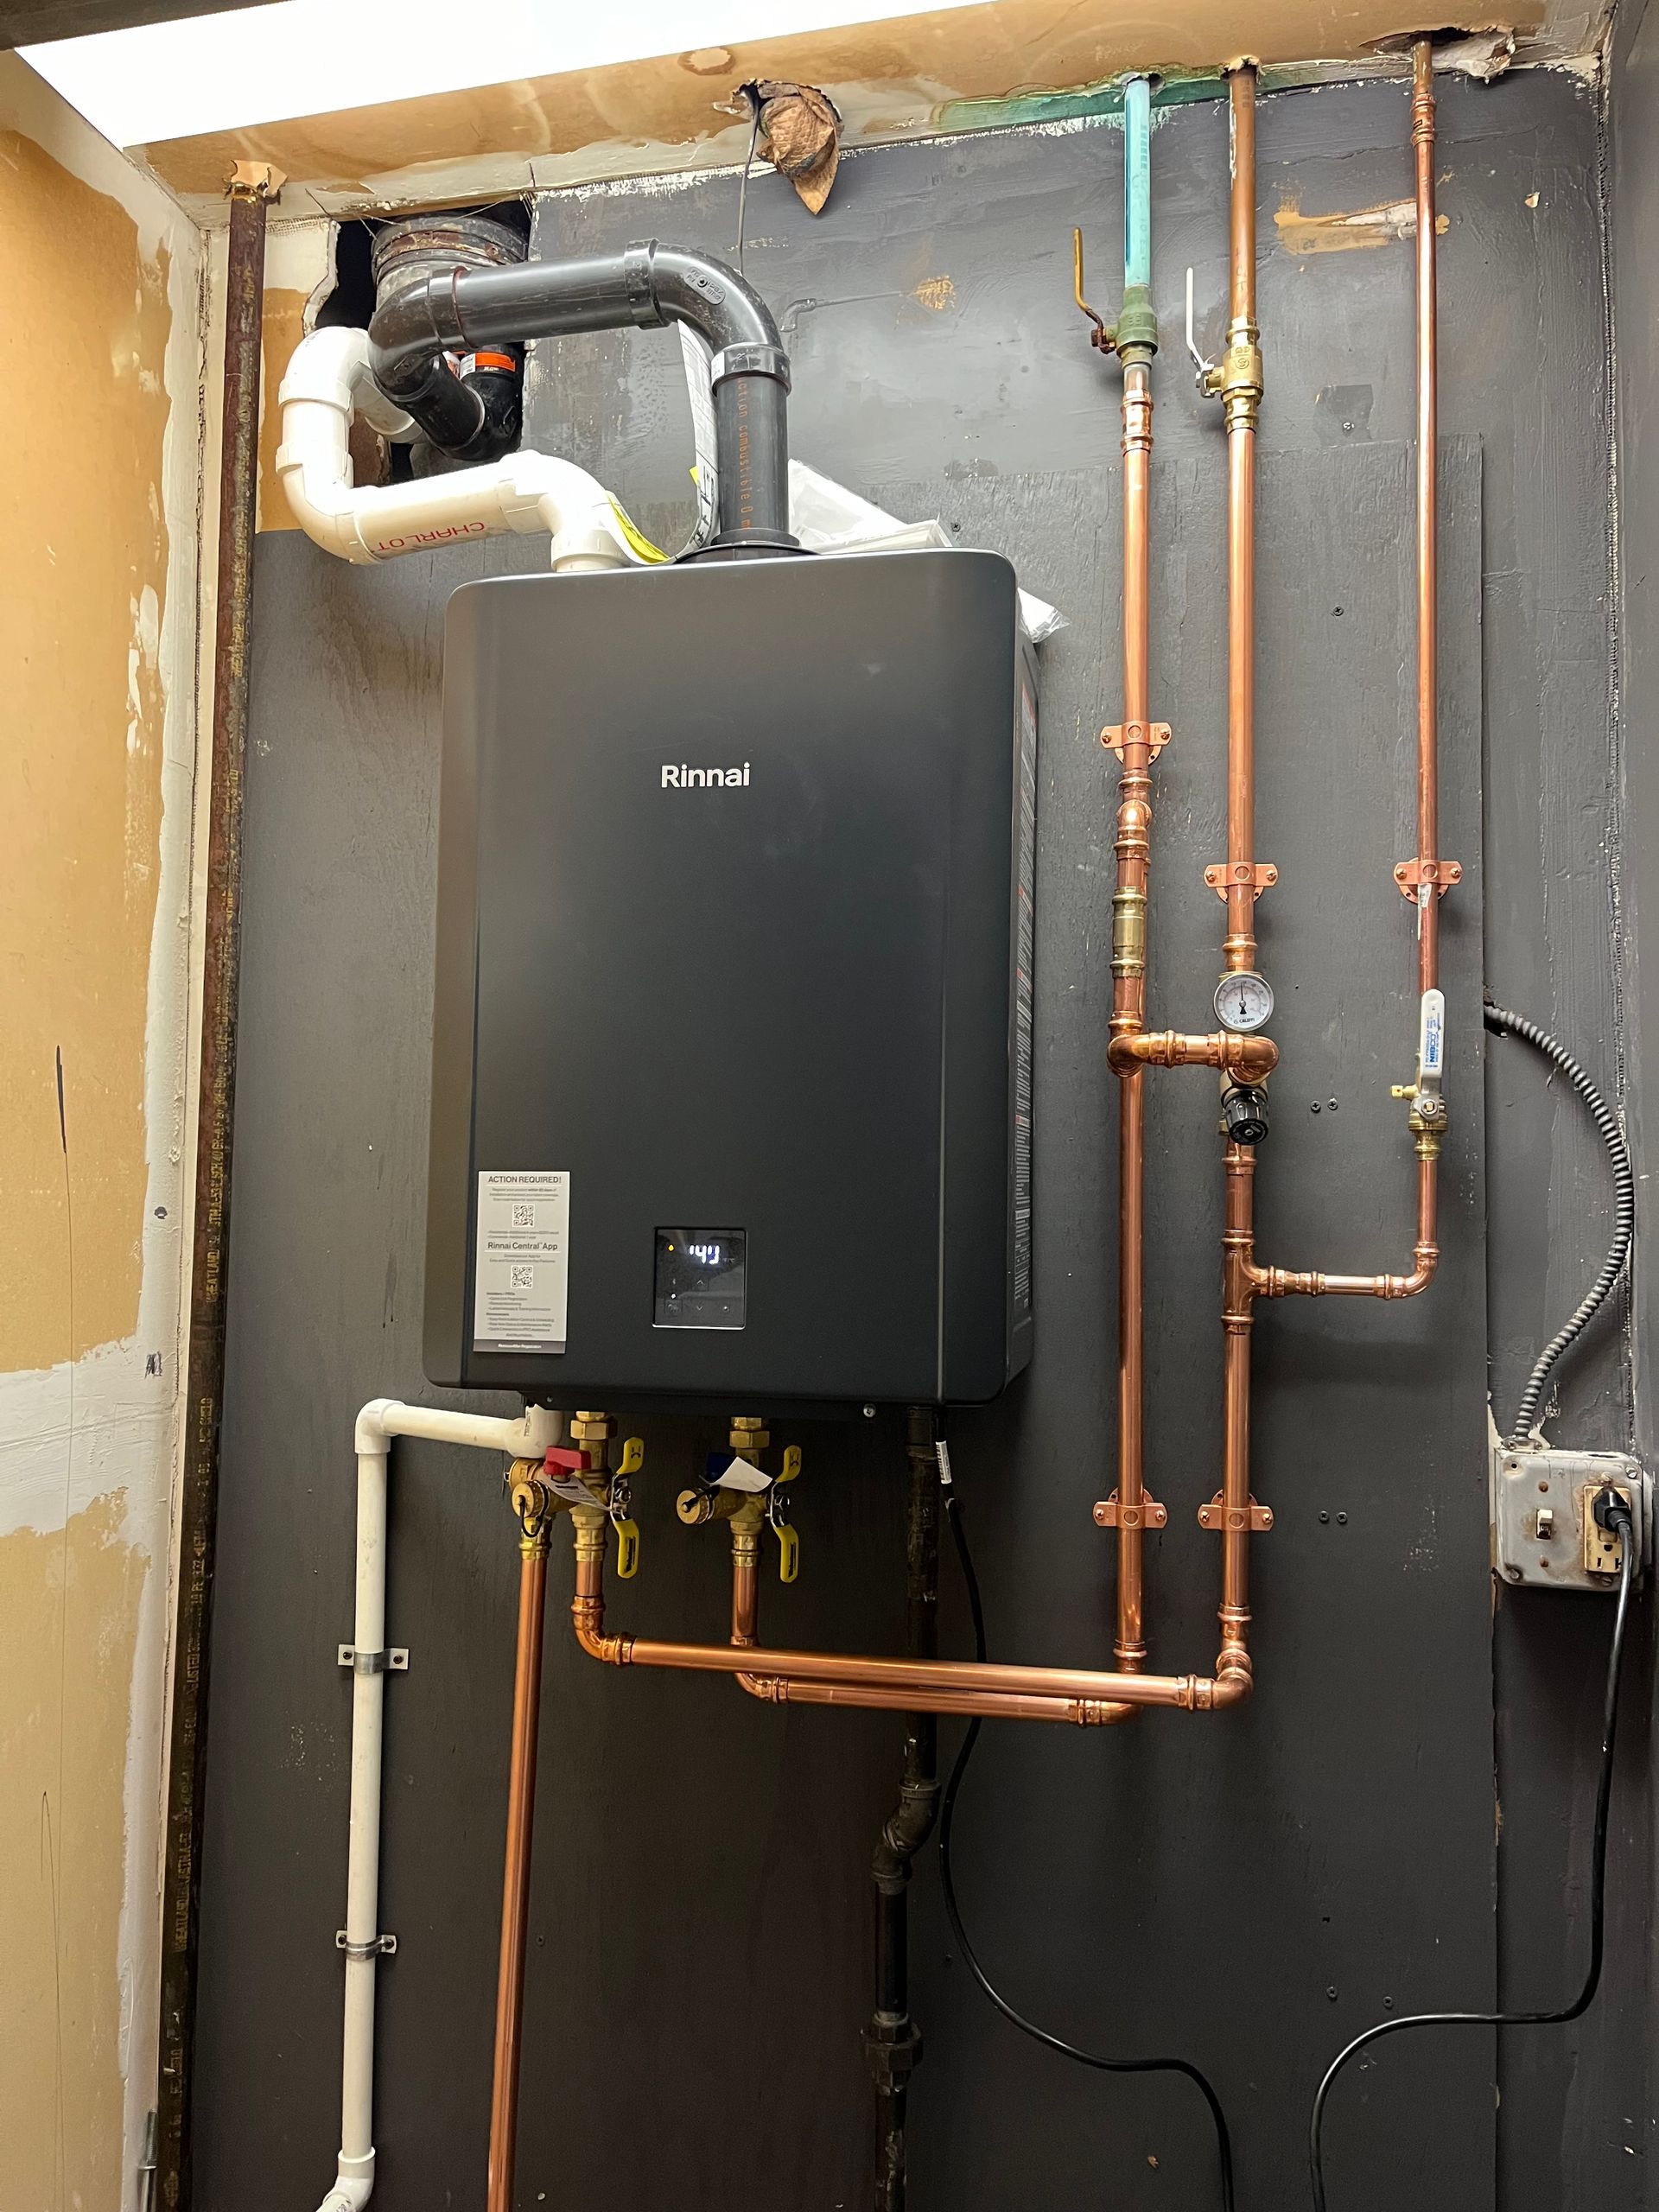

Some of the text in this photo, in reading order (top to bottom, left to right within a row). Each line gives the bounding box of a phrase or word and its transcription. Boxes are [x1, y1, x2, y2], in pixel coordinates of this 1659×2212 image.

[661, 761, 751, 788] Rinnai
[487, 1175, 518, 1184] ACTION
[542, 1242, 558, 1252] App
